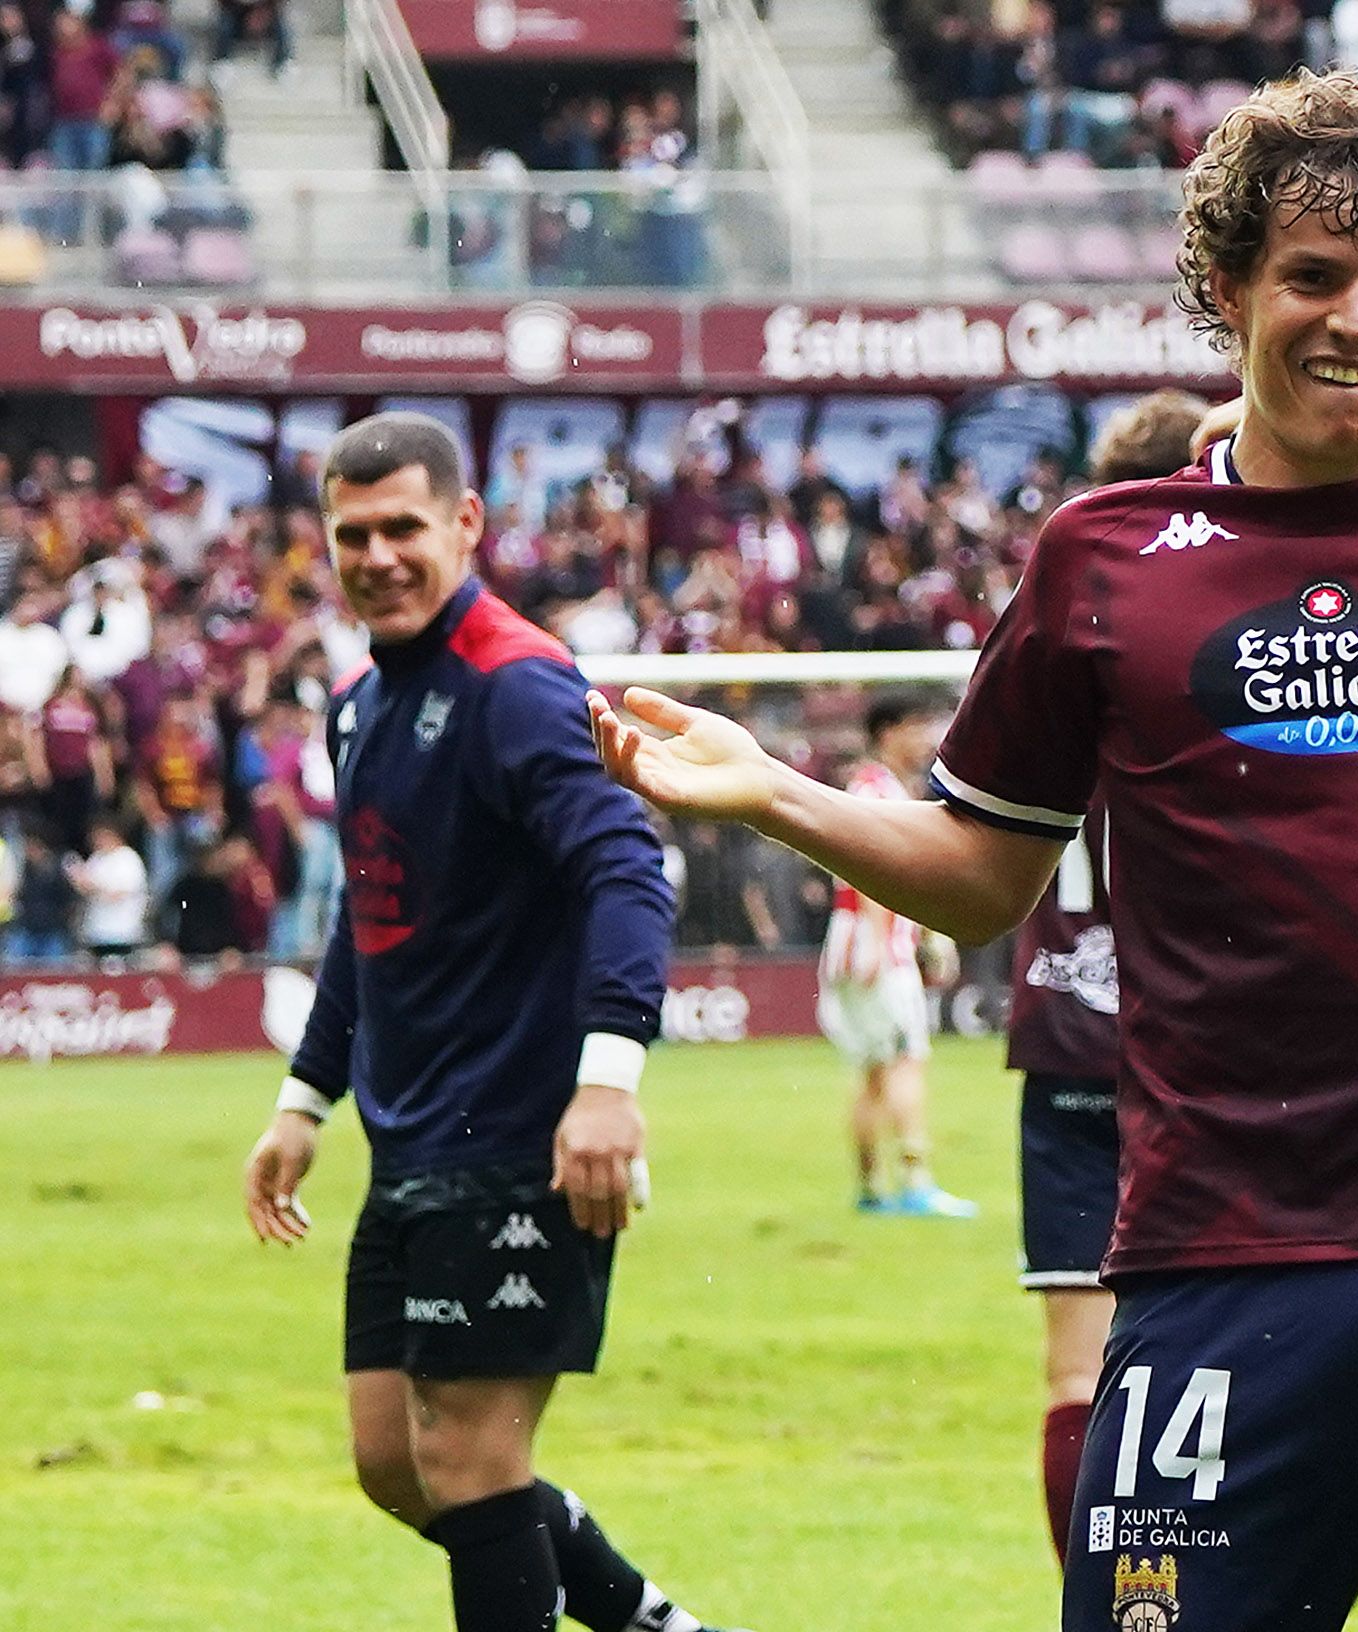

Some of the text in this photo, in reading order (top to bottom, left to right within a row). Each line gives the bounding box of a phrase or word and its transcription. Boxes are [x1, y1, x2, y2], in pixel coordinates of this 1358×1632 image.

[1113, 1366, 1232, 1501] 14
[1120, 1509, 1188, 1526] XUNTA
[1119, 1529, 1231, 1547] DE GALICIA
